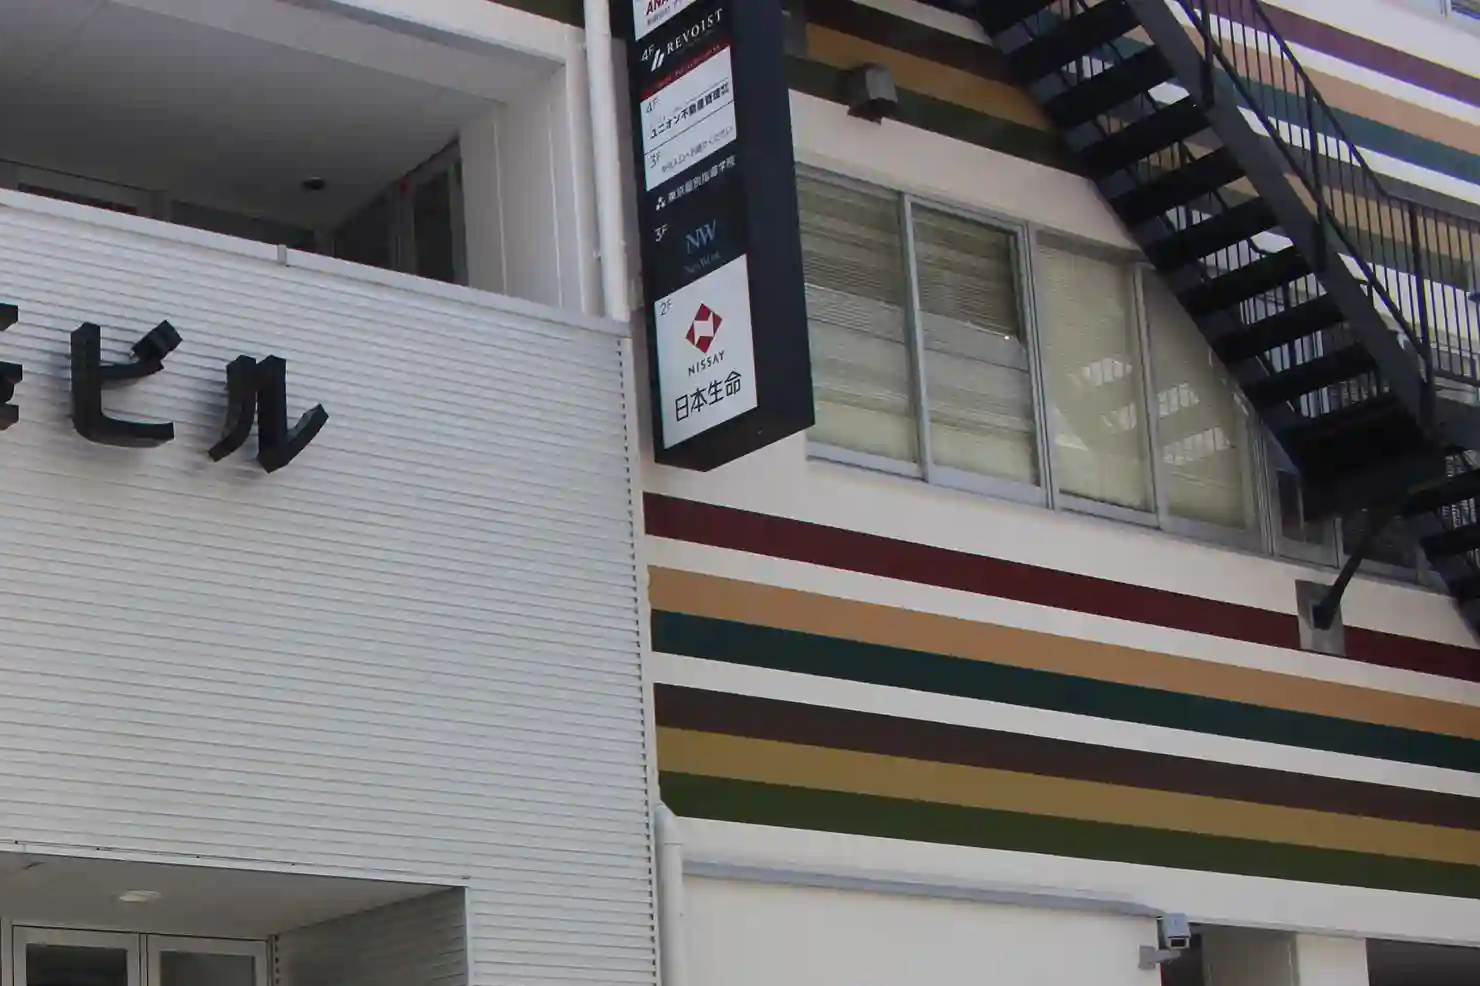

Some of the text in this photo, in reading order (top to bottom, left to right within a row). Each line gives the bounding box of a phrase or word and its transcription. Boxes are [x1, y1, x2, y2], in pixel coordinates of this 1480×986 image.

[666, 8, 723, 54] REVOIST
[654, 223, 668, 242] 3F
[660, 298, 672, 316] 2F
[688, 350, 725, 377] NISSAY
[675, 370, 742, 422] 日本生命
